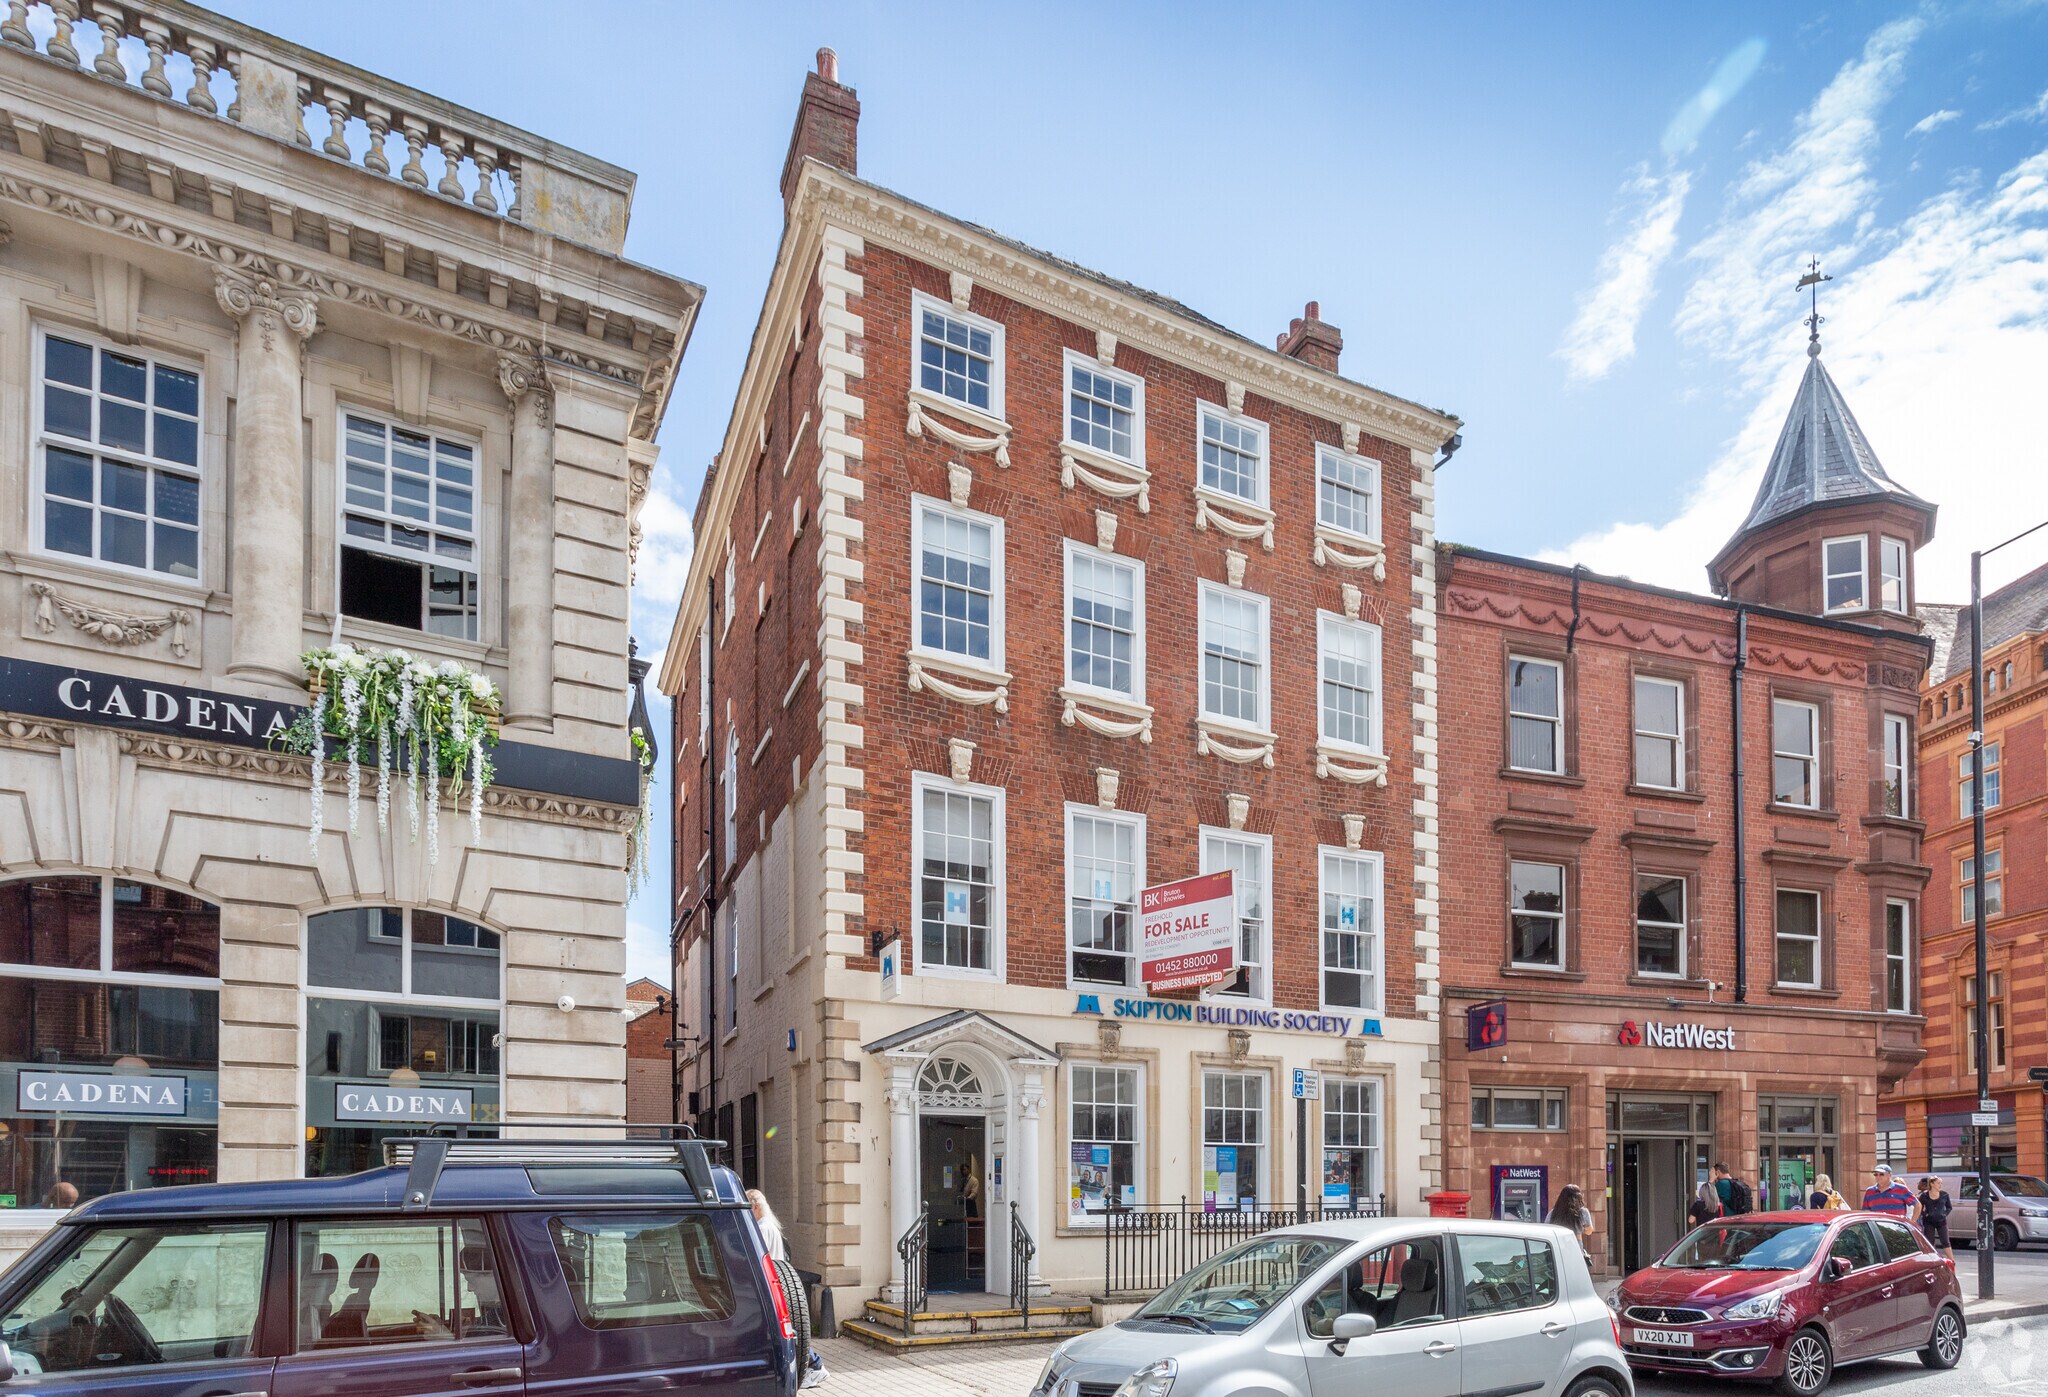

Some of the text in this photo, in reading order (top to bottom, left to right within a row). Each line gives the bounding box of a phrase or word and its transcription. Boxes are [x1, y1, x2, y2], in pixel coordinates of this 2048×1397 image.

[57, 677, 291, 741] CADENA
[1144, 891, 1160, 908] BK
[1163, 888, 1181, 897] Bruton
[1163, 893, 1186, 903] Knowles
[1144, 911, 1173, 923] FREEHOLD
[1144, 913, 1209, 939] FOR SALE
[1144, 926, 1230, 948] REDEVELOPMENT OPPORTUNITY
[1155, 953, 1218, 974] 01452 880000
[1152, 971, 1223, 991] BUSINESS UNAFFECTED
[1113, 998, 1352, 1037] SKIPTON BUILDING SOCIETY
[1645, 1021, 1736, 1051] NatWest
[26, 1081, 178, 1105] CADENA
[342, 1093, 466, 1115] CADENA
[1509, 1168, 1541, 1178] NatWest
[1637, 1330, 1688, 1345] VX20 XJT
